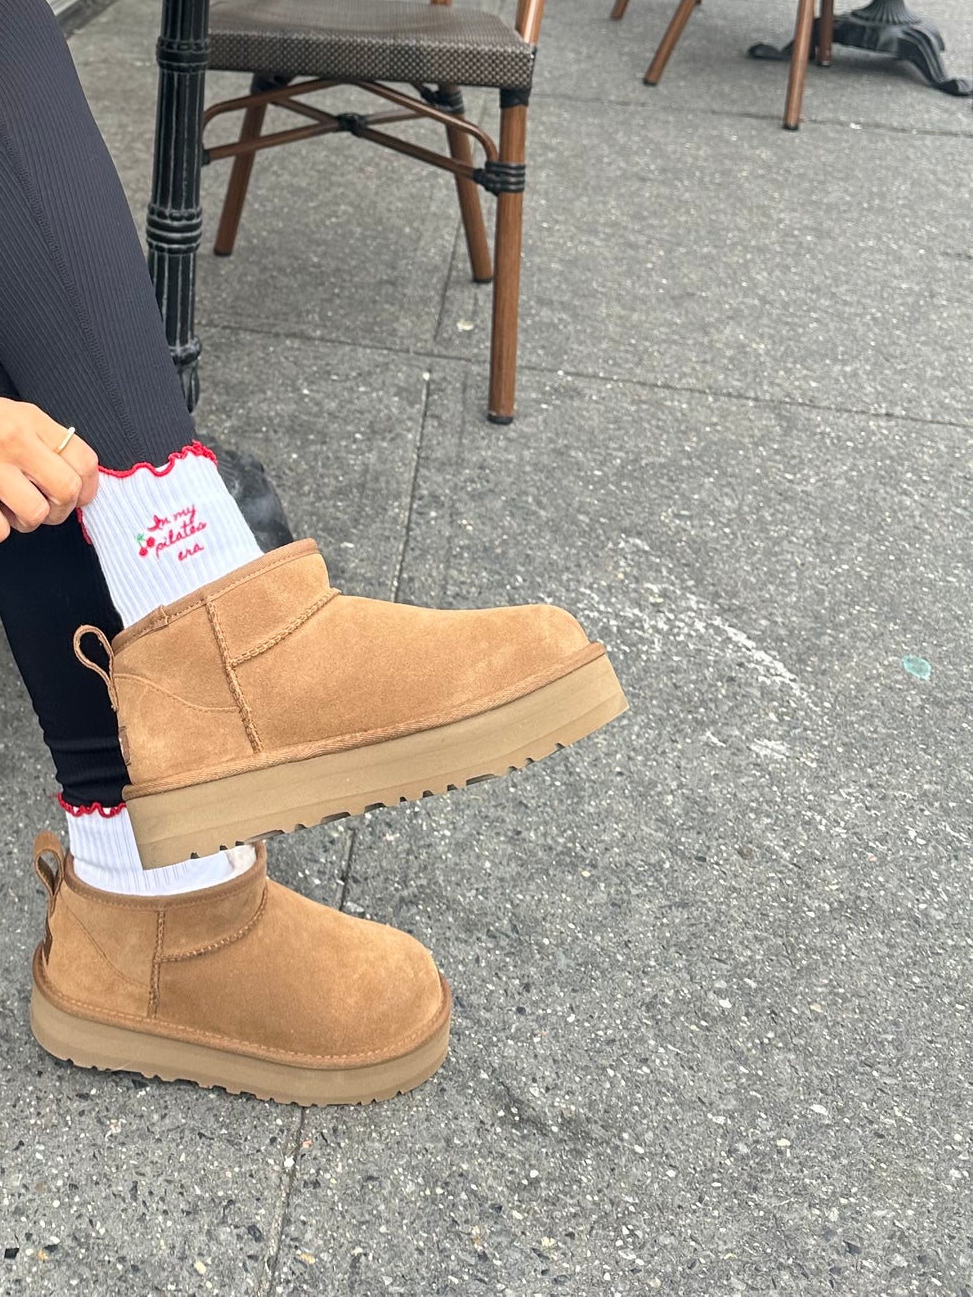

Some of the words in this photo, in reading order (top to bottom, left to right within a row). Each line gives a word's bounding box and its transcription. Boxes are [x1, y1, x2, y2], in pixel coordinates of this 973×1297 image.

[147, 514, 172, 533] In
[173, 504, 197, 525] my
[155, 520, 207, 560] pilates
[178, 543, 205, 562] era
